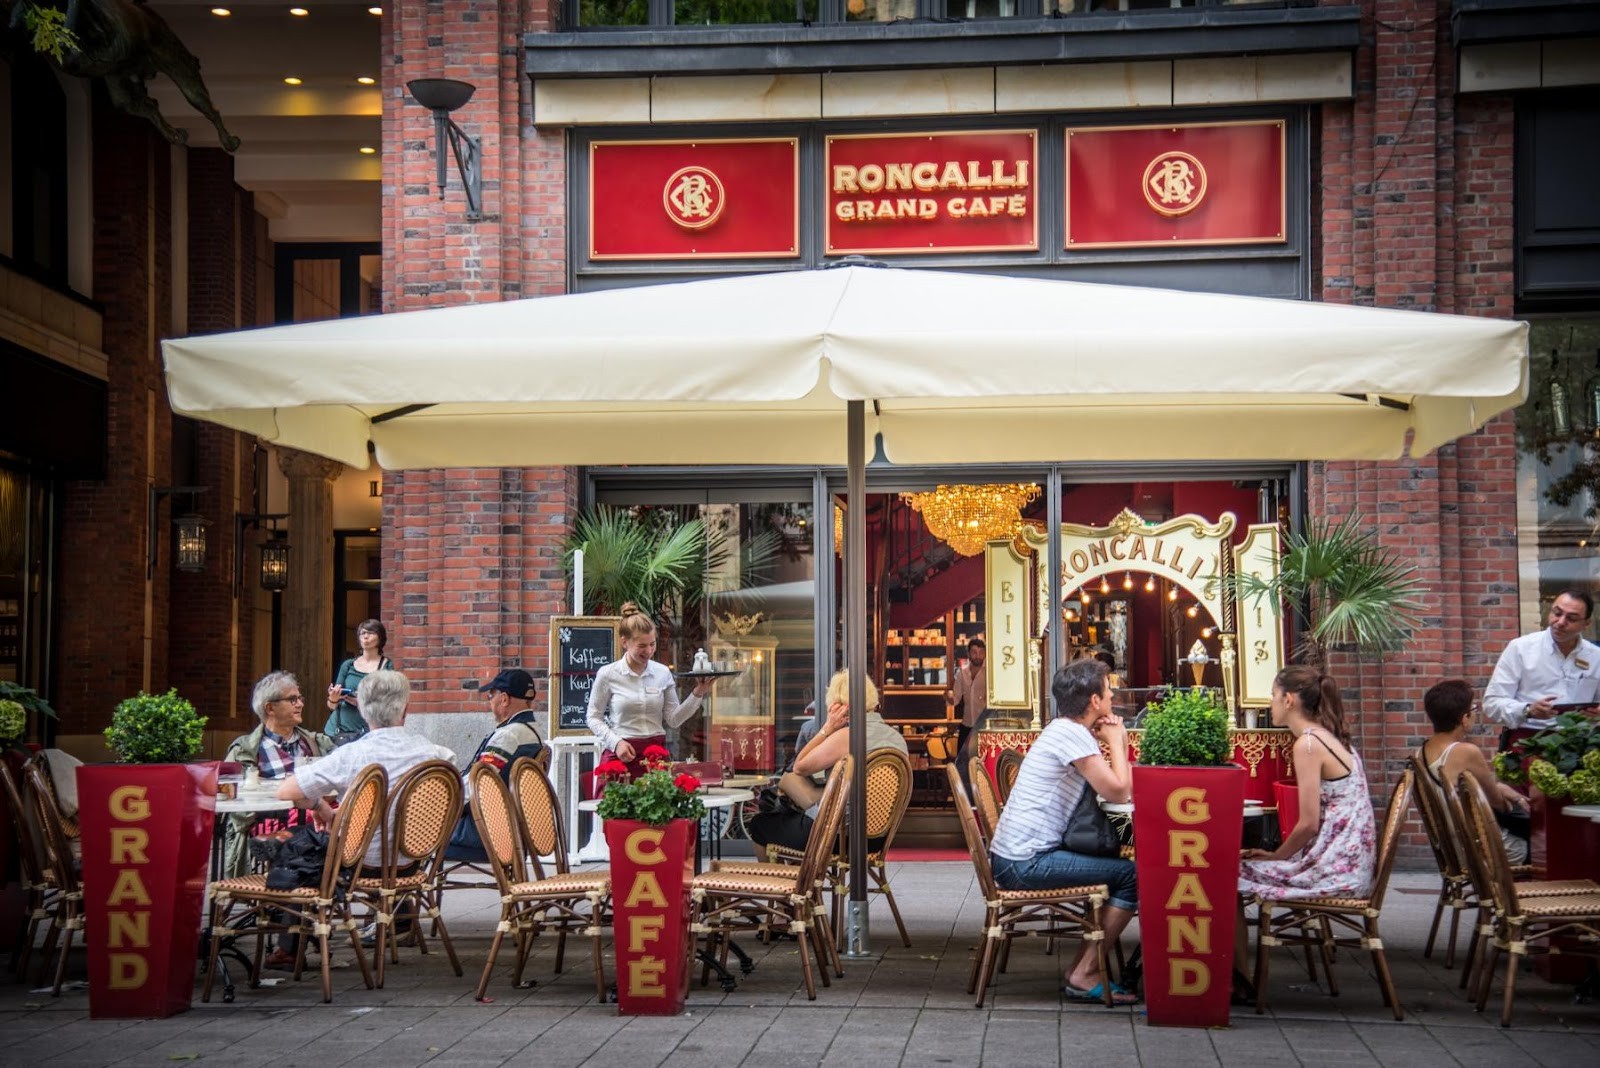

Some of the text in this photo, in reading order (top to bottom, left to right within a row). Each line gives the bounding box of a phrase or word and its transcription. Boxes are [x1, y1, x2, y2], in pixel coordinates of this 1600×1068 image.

[833, 160, 1029, 192] RONCALLI
[835, 194, 1027, 220] GRAND CAFÉ
[569, 647, 610, 669] Kaffee
[1001, 581, 1016, 670] EIS
[1252, 571, 1269, 666] IS
[569, 673, 595, 691] Kuch
[107, 785, 153, 991] GRAND
[624, 828, 669, 998] CAFÉ
[1165, 786, 1213, 997] GRAND
